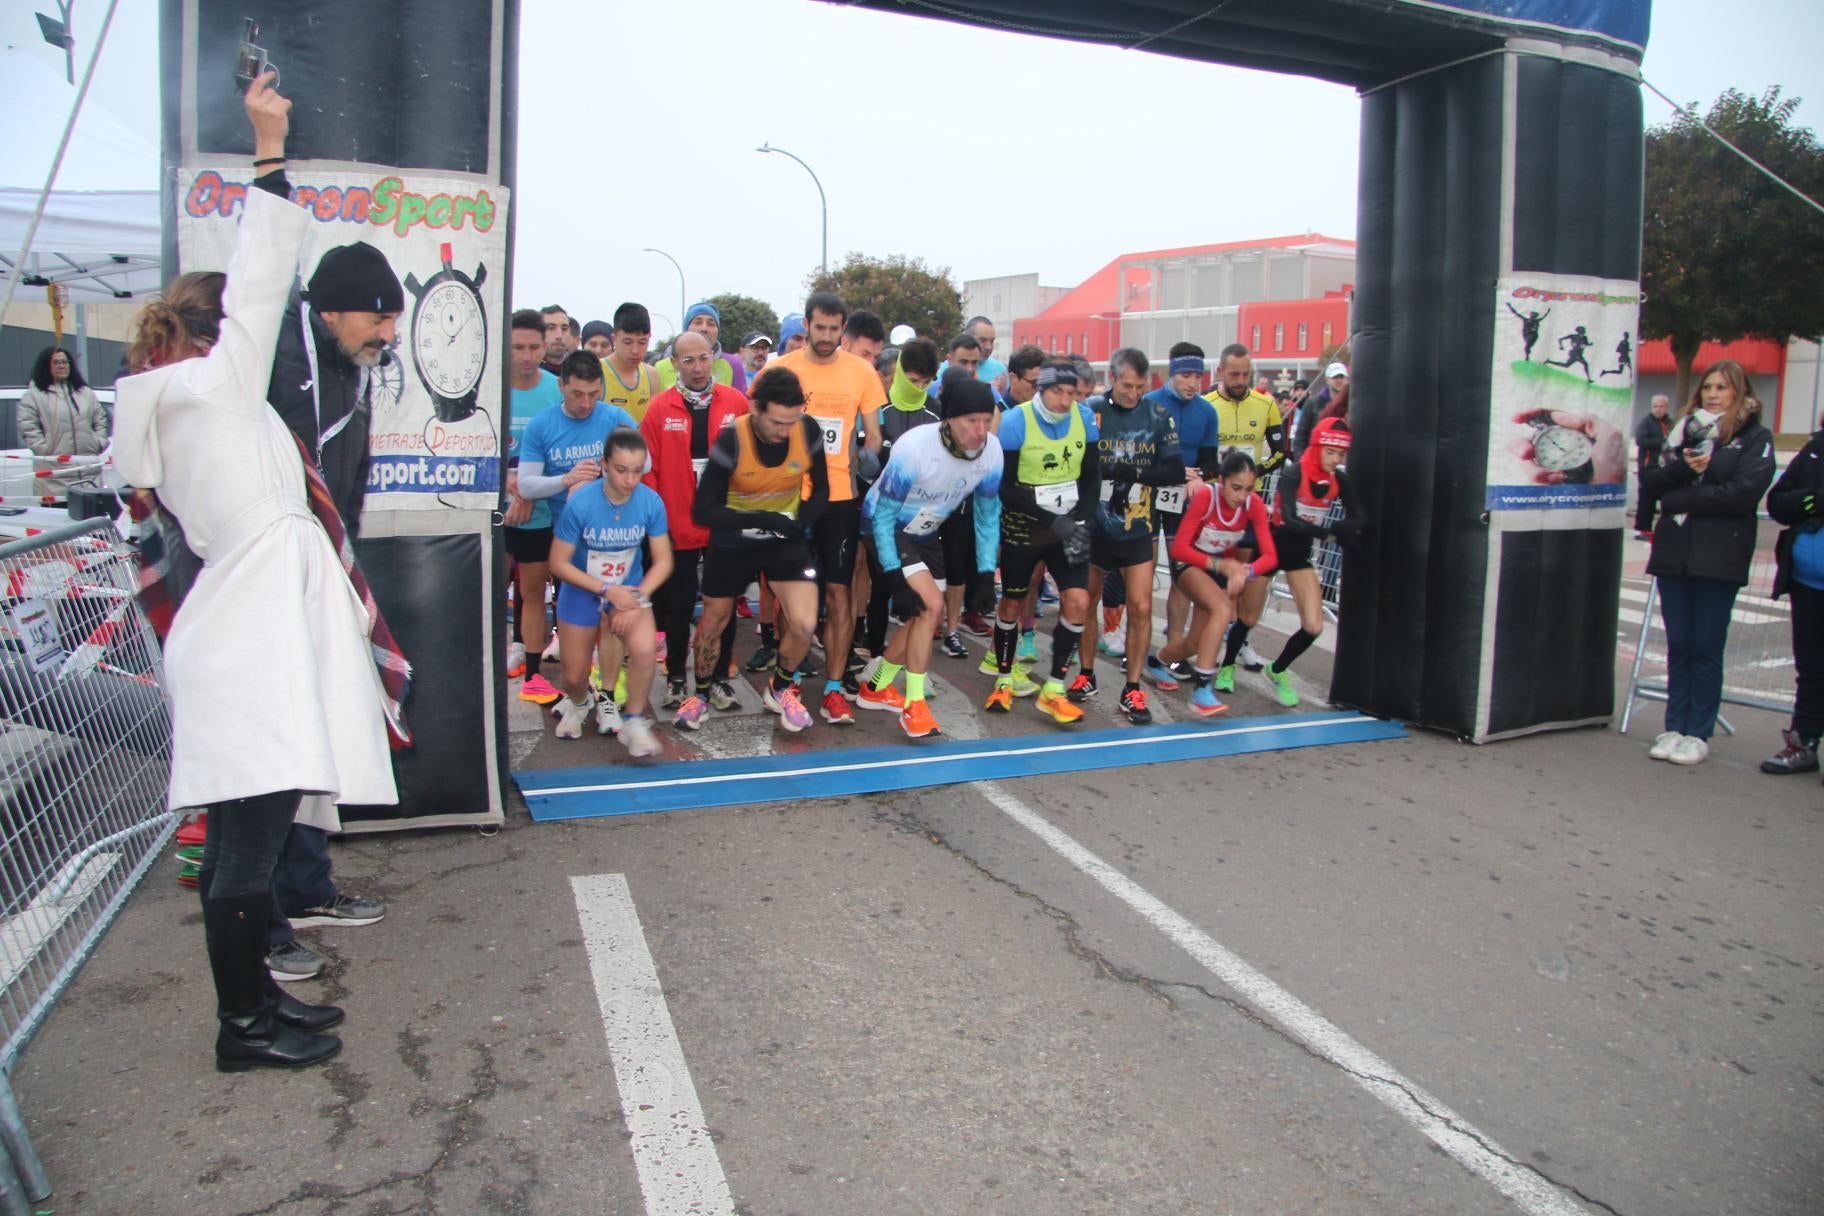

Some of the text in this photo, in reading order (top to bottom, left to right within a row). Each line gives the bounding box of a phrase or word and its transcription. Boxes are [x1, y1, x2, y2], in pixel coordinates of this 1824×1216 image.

[185, 170, 496, 238] OrronSport
[370, 432, 424, 450] METRAJE
[825, 430, 837, 444] 9
[550, 440, 605, 461] LA ARMUÑ
[368, 457, 477, 491] sport.com
[1054, 494, 1062, 507] 1
[1160, 490, 1180, 504] 31
[583, 524, 646, 541] LA ARMUÑA
[600, 561, 626, 577] 25
